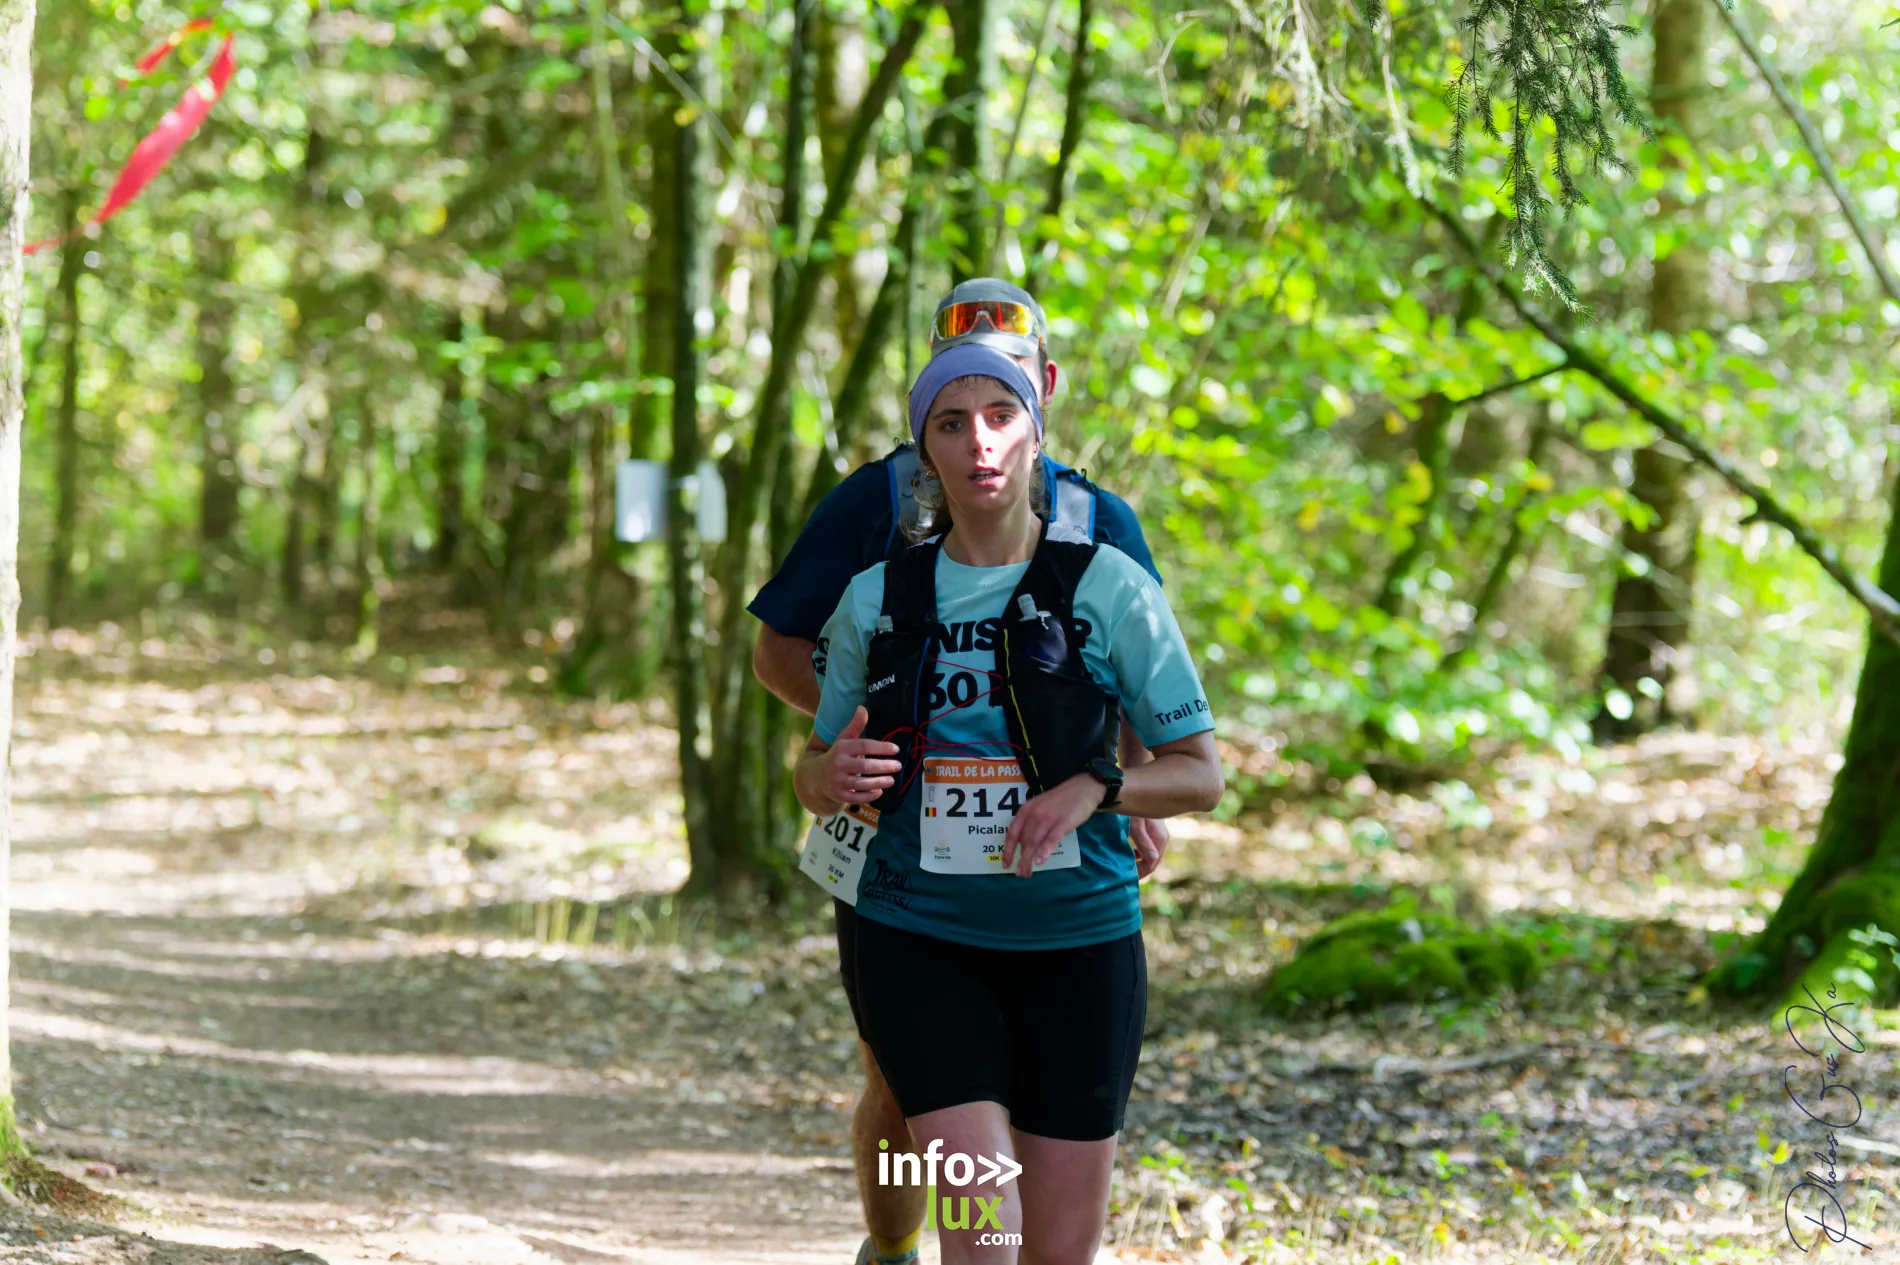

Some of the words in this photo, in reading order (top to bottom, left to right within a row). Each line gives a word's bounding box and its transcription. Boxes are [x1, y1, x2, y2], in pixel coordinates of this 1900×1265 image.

[868, 674, 896, 693] OMON
[1154, 702, 1193, 726] Trail
[935, 765, 961, 777] TRAIL
[964, 765, 978, 777] DE
[980, 765, 995, 777] LA
[997, 764, 1023, 777] PASS
[946, 787, 1033, 818] 214
[823, 814, 875, 853] 201
[982, 844, 996, 853] 20
